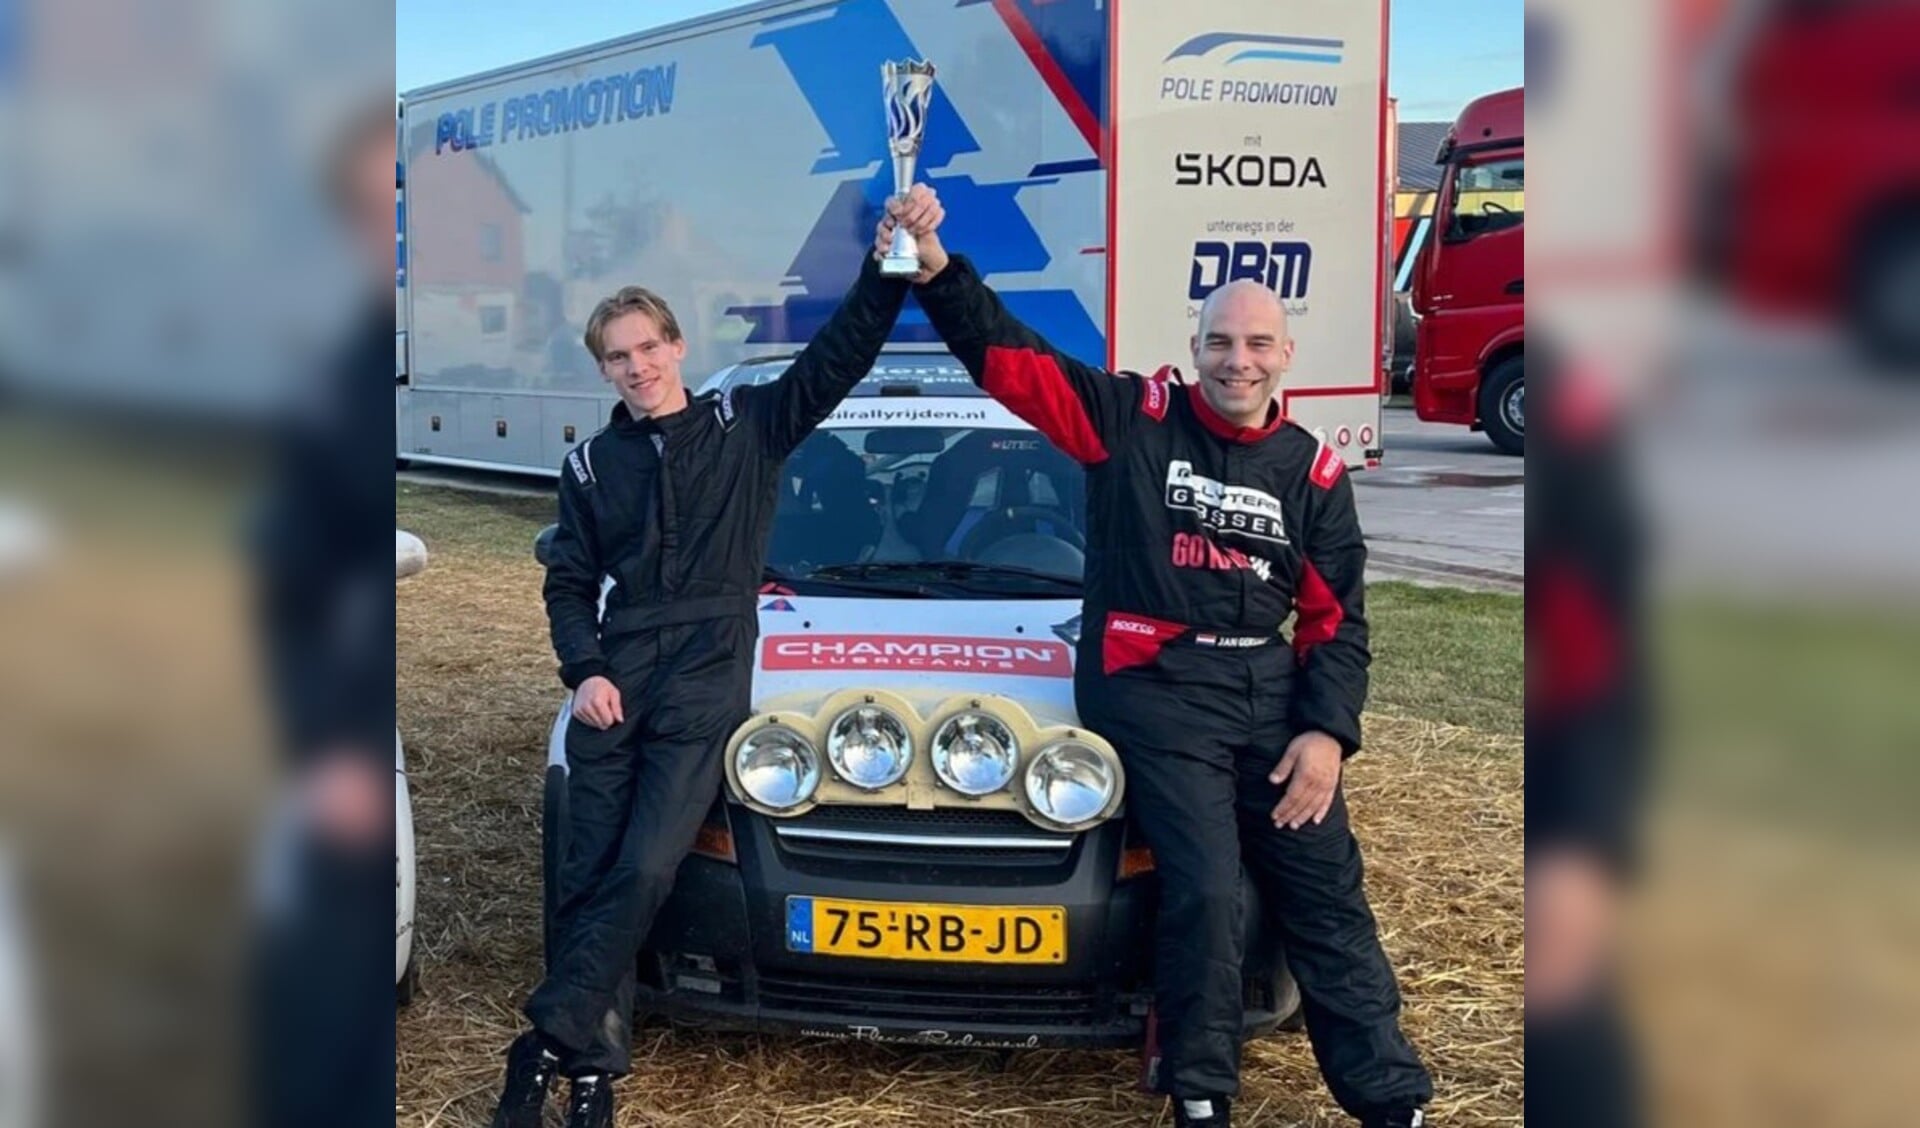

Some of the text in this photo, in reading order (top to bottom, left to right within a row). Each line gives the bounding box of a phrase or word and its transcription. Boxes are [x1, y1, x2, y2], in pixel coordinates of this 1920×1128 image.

[1161, 77, 1338, 107] POLE PROMOTION
[435, 62, 677, 156] POLE PROMOTION
[1244, 134, 1262, 147] mit
[1206, 219, 1295, 236] unterwegs in der
[1172, 532, 1205, 568] GO
[1217, 636, 1238, 648] JAN
[776, 641, 1051, 662] CHAMPION
[811, 656, 1015, 669] LUBRICANTS
[791, 931, 811, 944] NL
